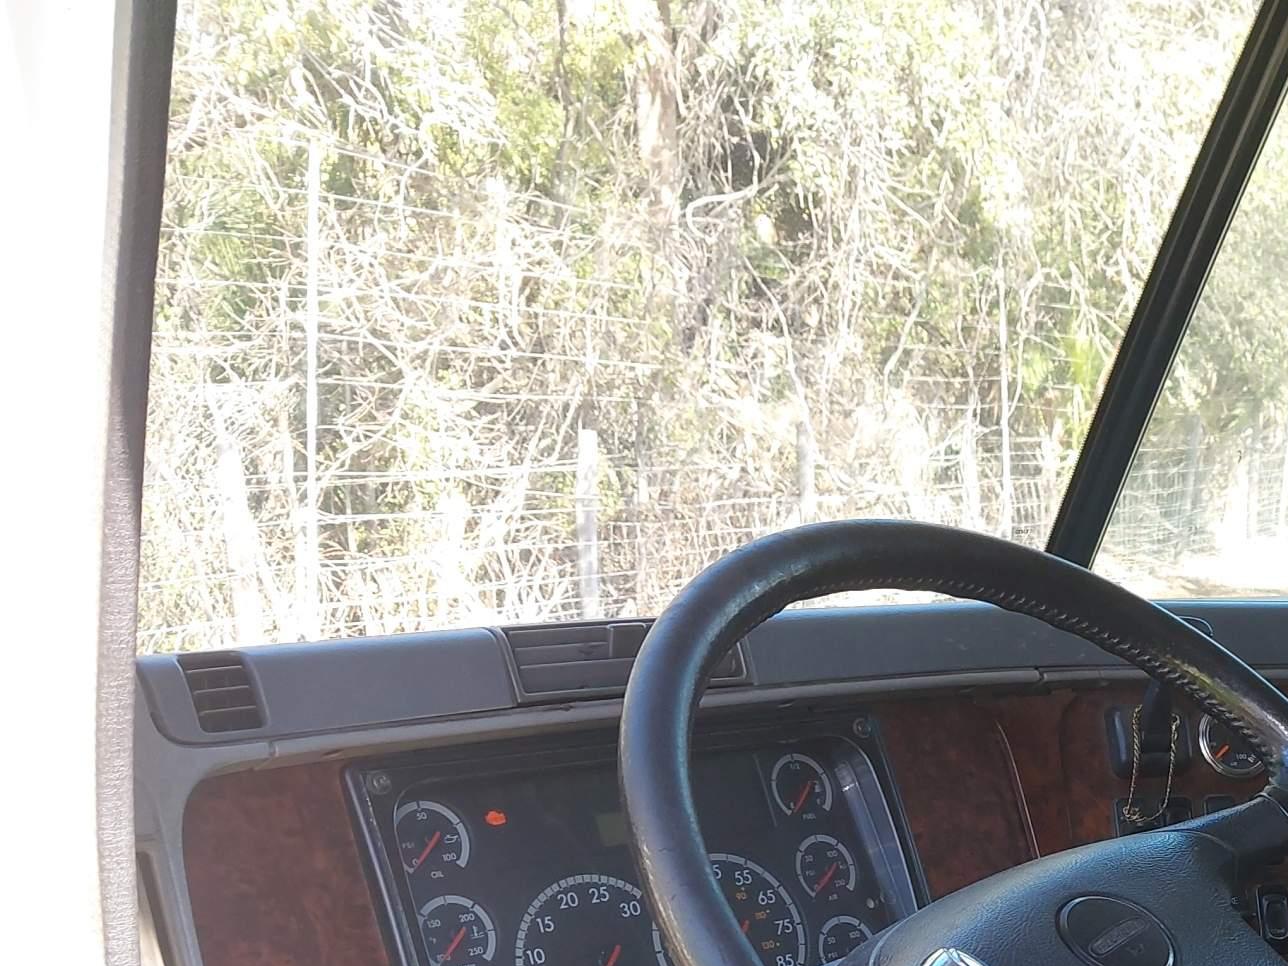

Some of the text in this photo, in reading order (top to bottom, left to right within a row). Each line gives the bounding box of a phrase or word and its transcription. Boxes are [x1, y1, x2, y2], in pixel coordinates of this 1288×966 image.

[416, 811, 428, 821] 50
[441, 852, 457, 862] 100
[430, 870, 445, 879] OIL
[734, 869, 752, 886] 55
[557, 891, 579, 909] 20
[588, 886, 610, 904] 25
[757, 889, 776, 905] 65
[619, 900, 641, 918] 30
[426, 918, 441, 928] 150
[458, 912, 476, 923] 200
[536, 915, 555, 934] 15
[773, 919, 793, 936] 75
[467, 945, 484, 957] 250
[526, 948, 546, 965] 10
